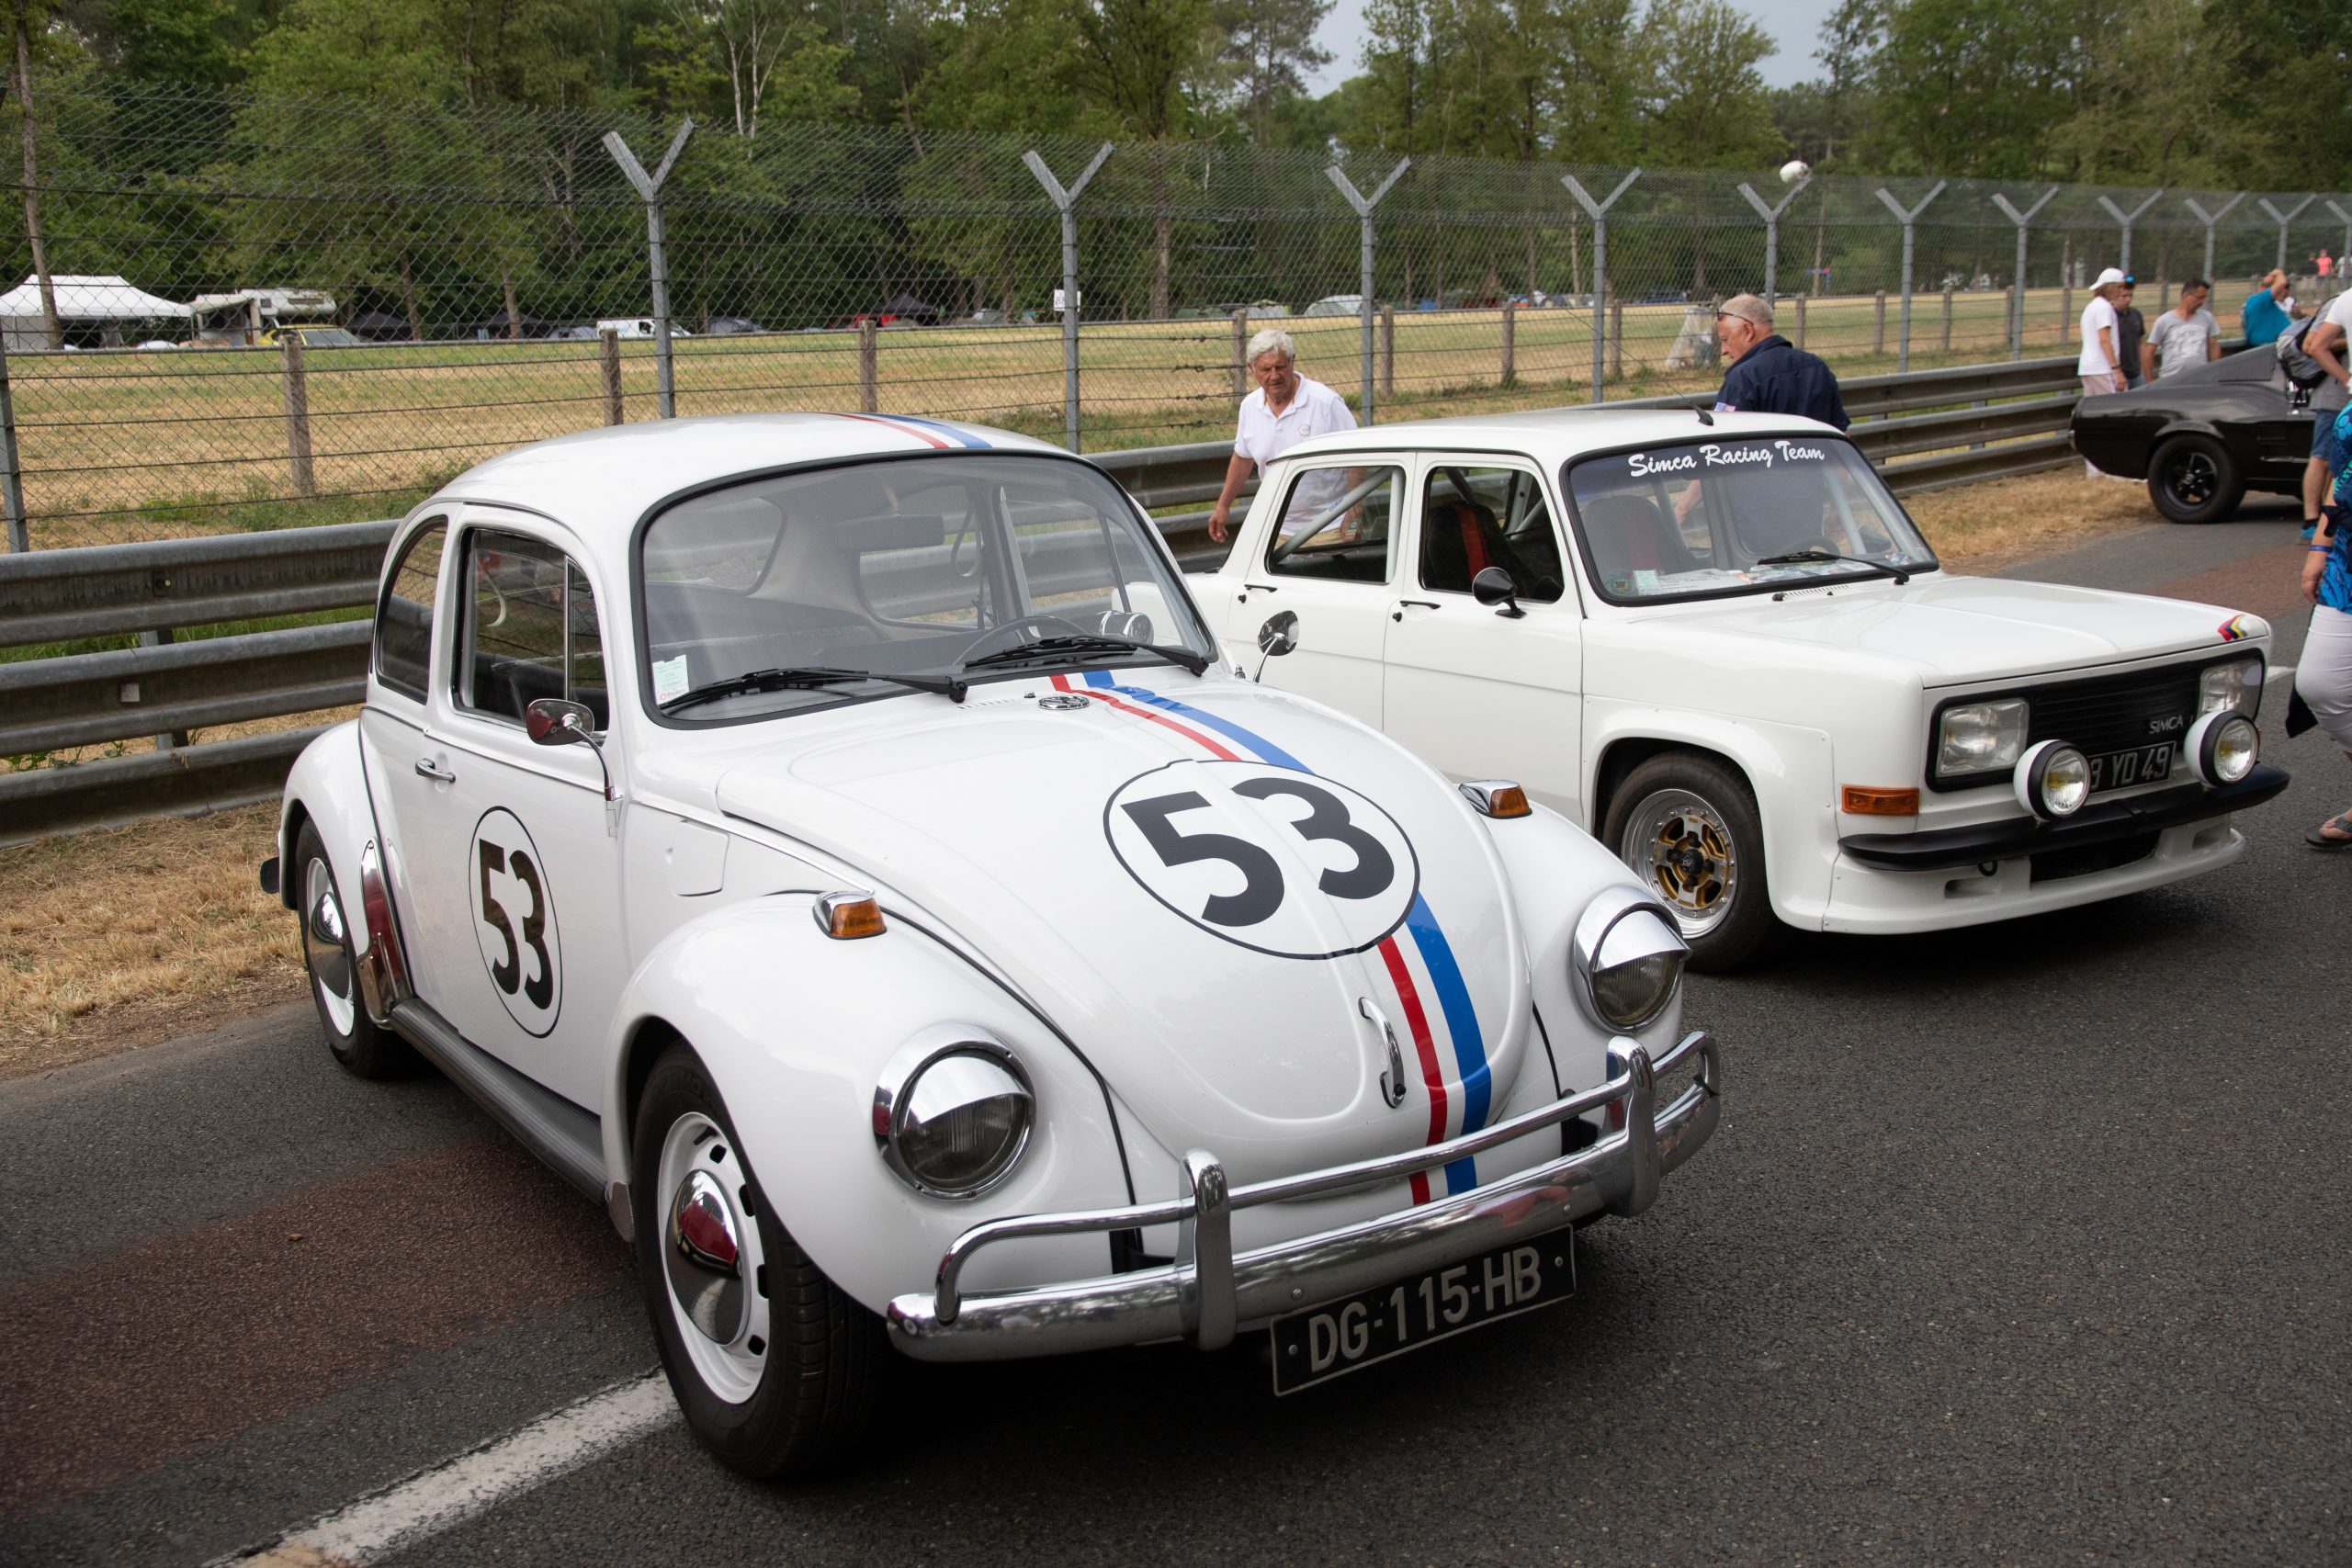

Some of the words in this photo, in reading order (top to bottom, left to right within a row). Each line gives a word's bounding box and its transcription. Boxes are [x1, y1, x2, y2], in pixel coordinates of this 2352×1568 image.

[1628, 453, 1697, 477] Simca
[1700, 445, 1773, 468] Racing
[1774, 440, 1825, 461] Team
[2149, 715, 2183, 734] SIMCA
[2112, 751, 2138, 787] YD
[2141, 746, 2169, 781] 49
[1119, 777, 1395, 927] 53
[479, 838, 553, 1010] 53
[1308, 1246, 1542, 1372] DG-115-HB
